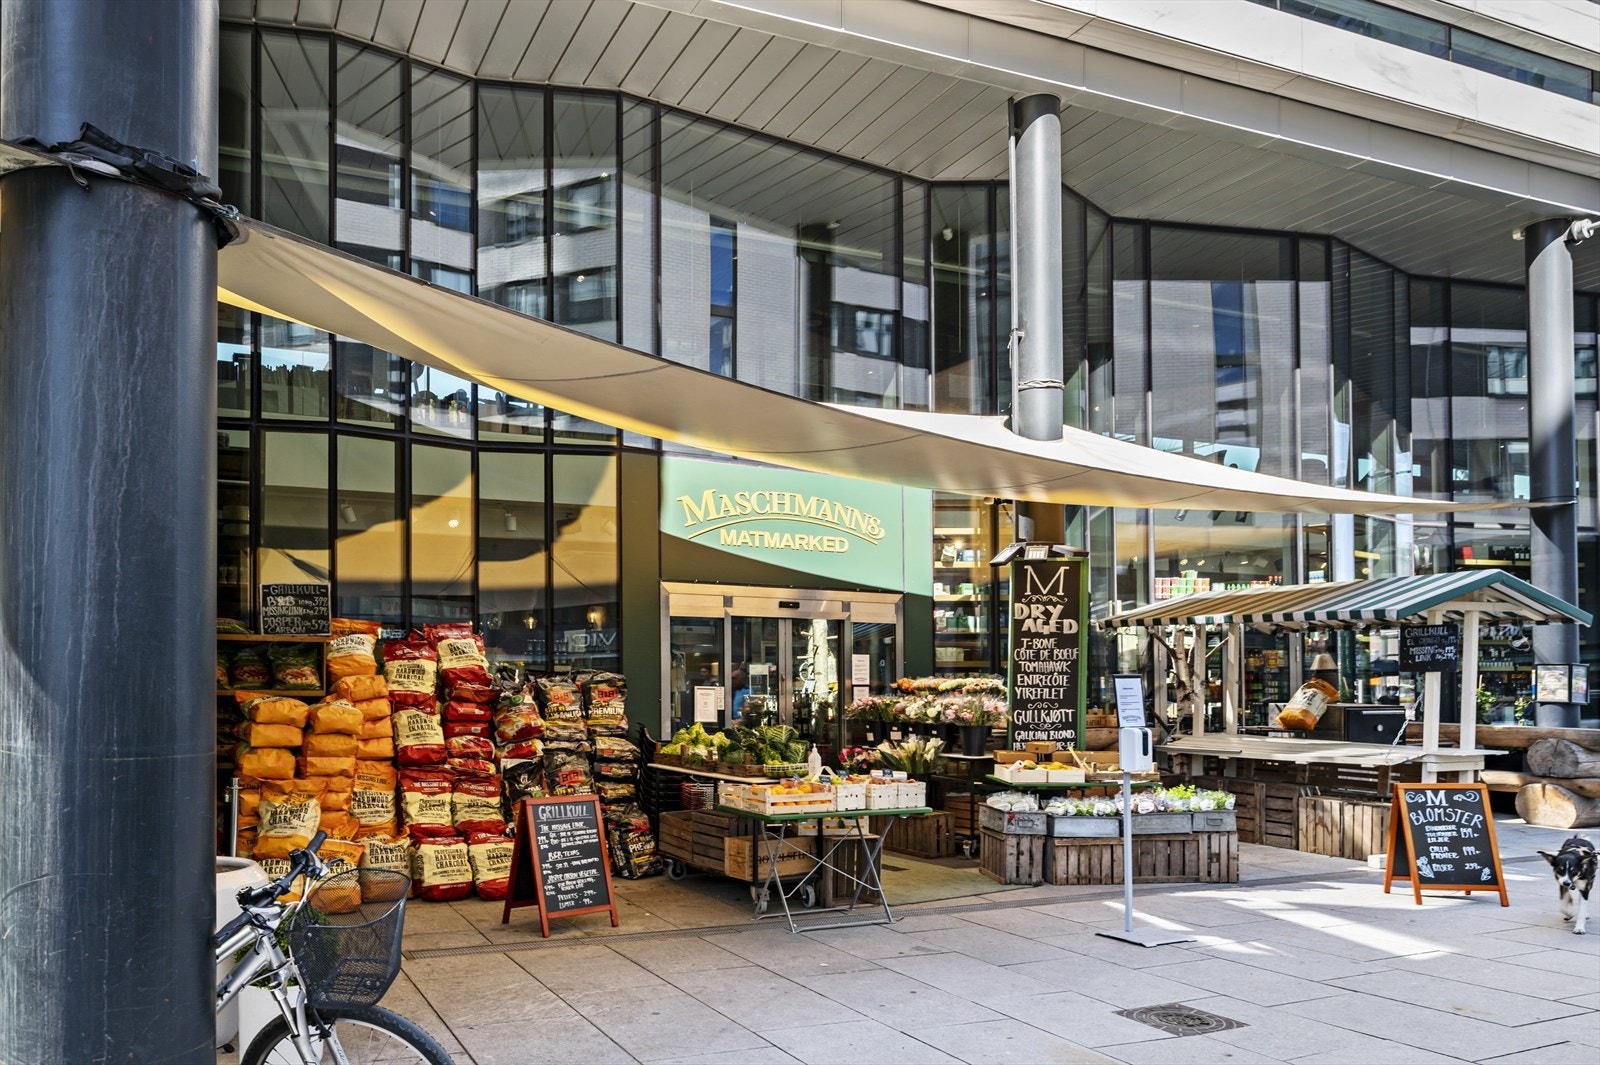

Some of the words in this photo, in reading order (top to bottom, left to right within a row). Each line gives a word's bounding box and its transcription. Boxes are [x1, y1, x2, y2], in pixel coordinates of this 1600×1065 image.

[677, 489, 885, 541] MASCHMANNS
[720, 528, 849, 553] MATMARKED
[1024, 565, 1069, 595] M
[1013, 603, 1064, 621] DRY
[1021, 619, 1078, 635] AGED
[1021, 638, 1058, 649] T-BONE
[1040, 649, 1051, 660] DE
[1018, 661, 1071, 673] TOMAHAWK
[1017, 672, 1070, 687] ENTRECÔTE
[1014, 687, 1067, 700] YTREFILET
[1013, 709, 1076, 725] GULLKJØTT
[1425, 790, 1449, 806] M
[538, 805, 591, 821] GRILLKULL
[1409, 808, 1483, 828] BLOMSTER
